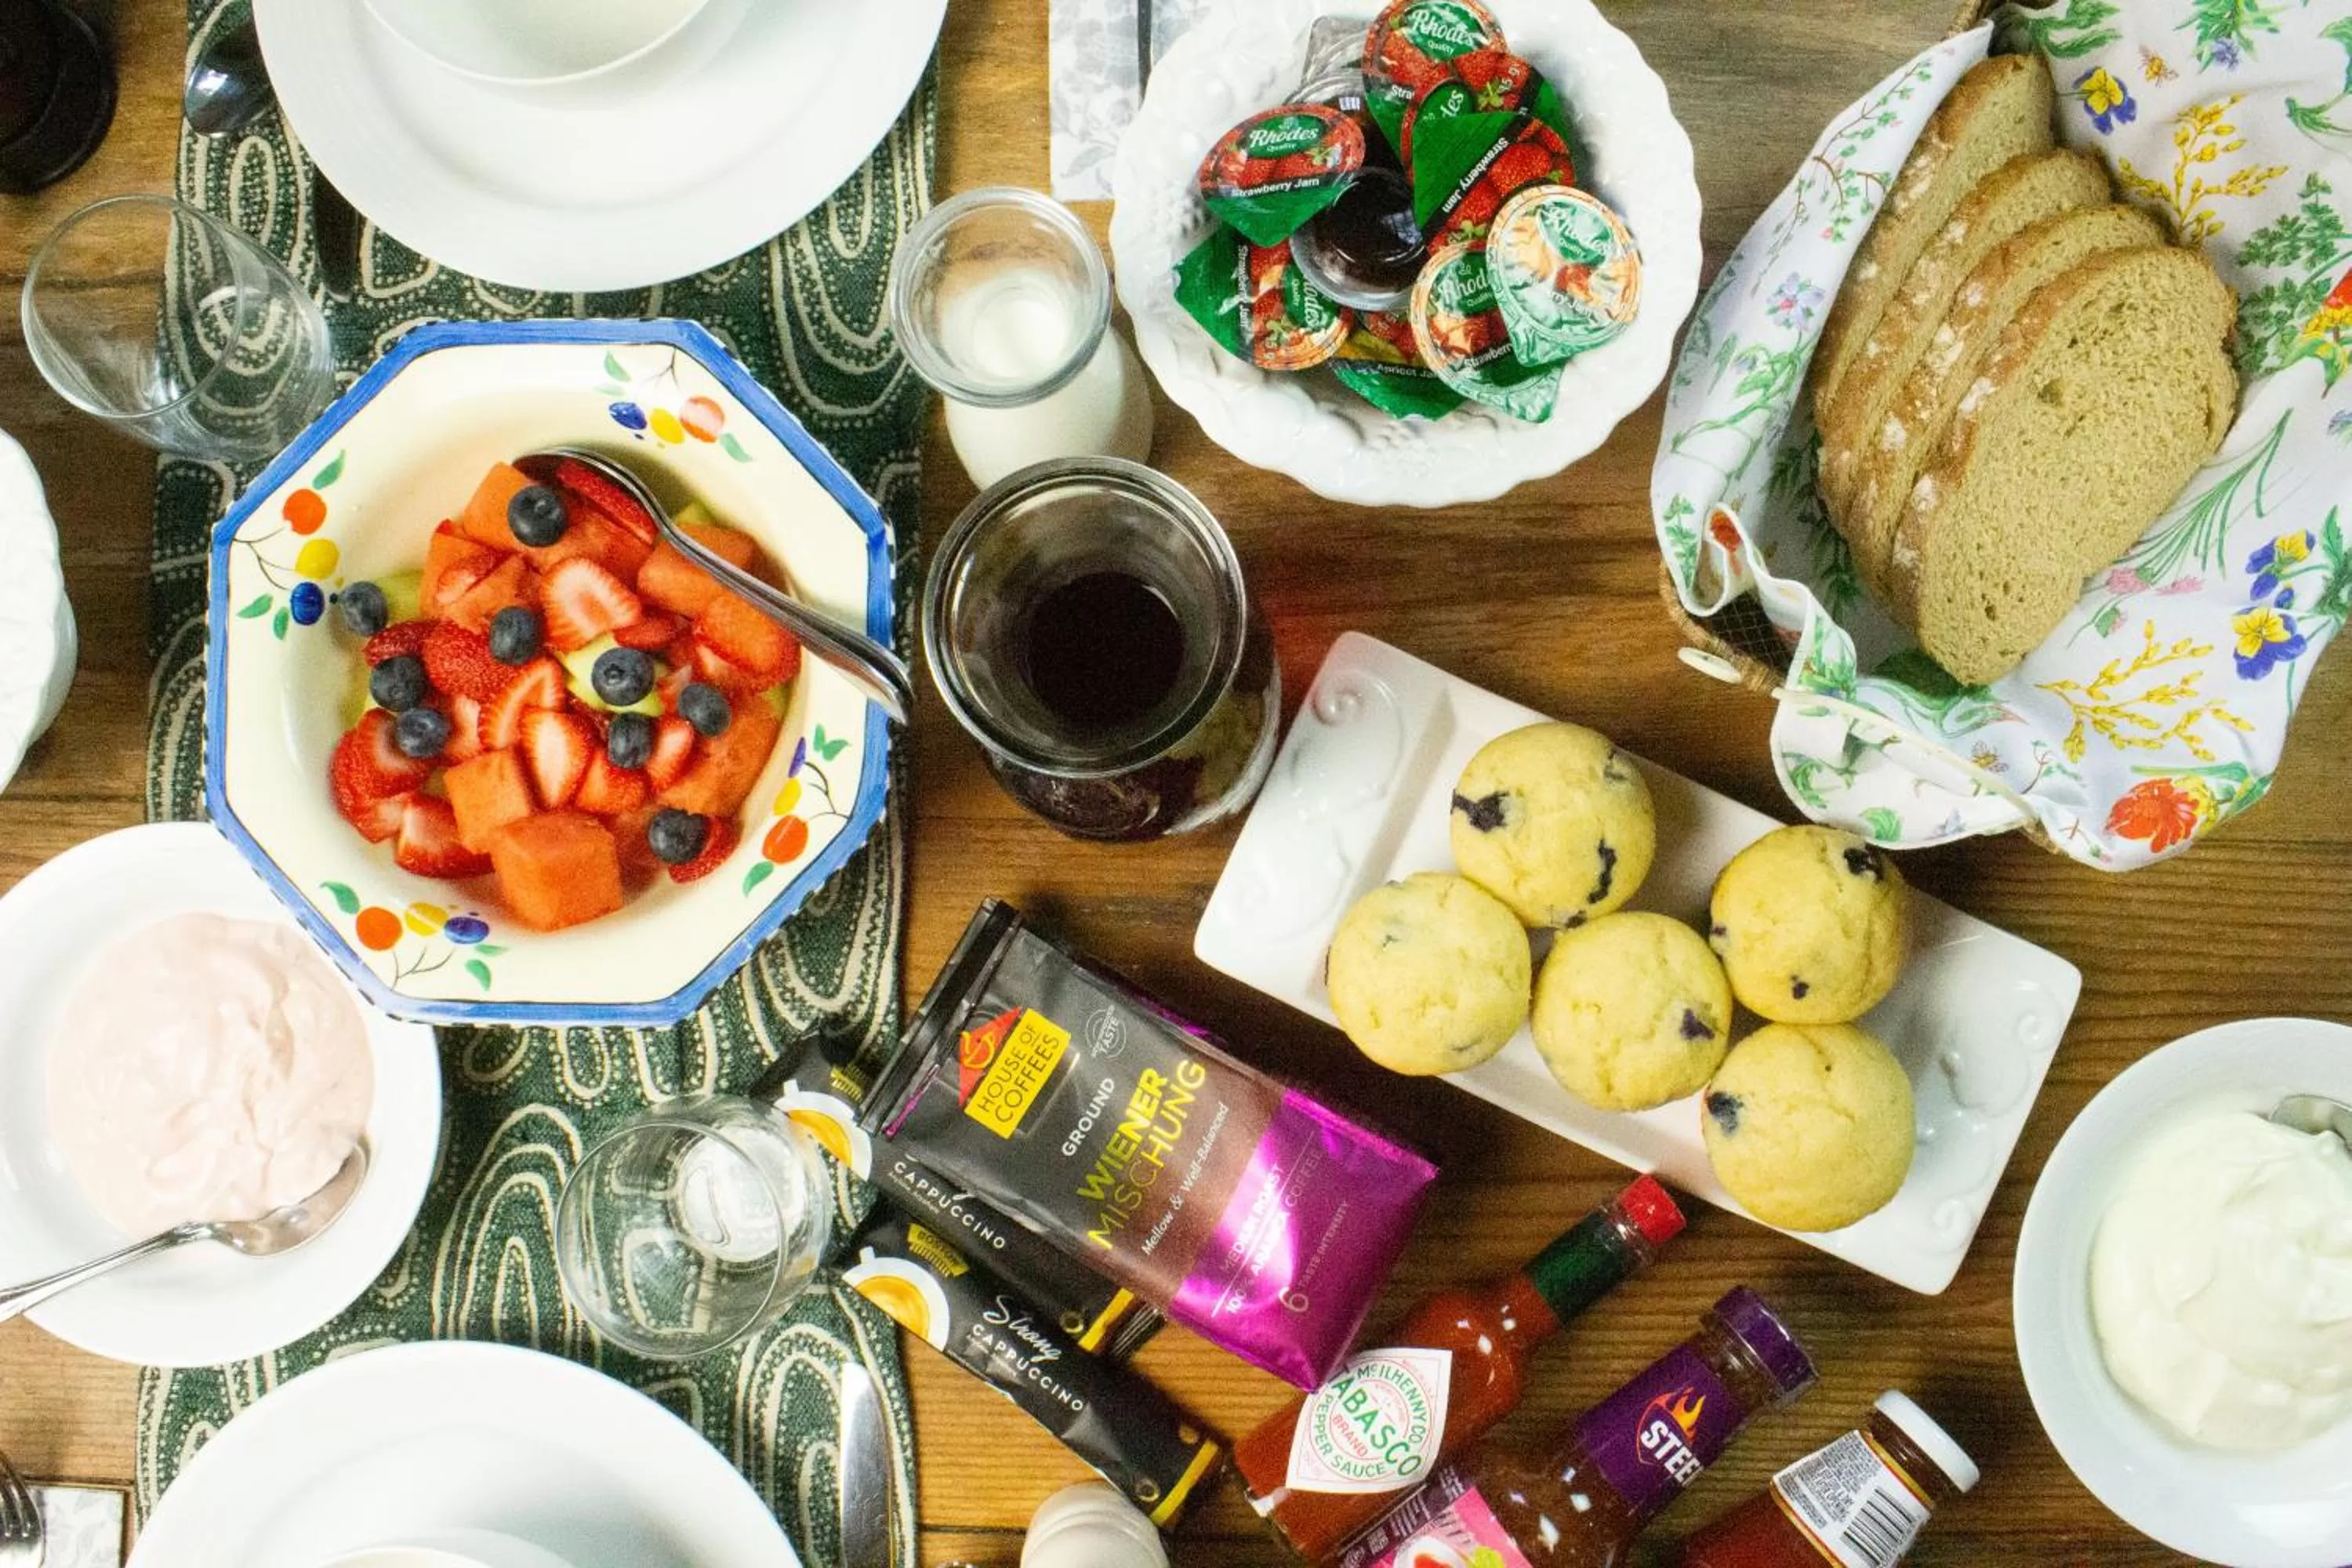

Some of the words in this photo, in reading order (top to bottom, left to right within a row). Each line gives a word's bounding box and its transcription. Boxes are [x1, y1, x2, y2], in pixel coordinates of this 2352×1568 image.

[1410, 9, 1475, 48] Rhodes
[1249, 126, 1319, 149] Rhodes
[1459, 136, 1510, 191] Strawberry
[1231, 180, 1291, 198] Strawberry
[1294, 177, 1320, 189] Jam
[1441, 189, 1462, 213] Jam
[1438, 268, 1489, 312] Rhod
[978, 1047, 1025, 1112] HOUSE
[1020, 1023, 1038, 1045] OF
[1098, 1015, 1120, 1054] TASTE
[995, 1033, 1059, 1123] COFFEES
[1062, 1078, 1115, 1156] GROUND
[1076, 1067, 1168, 1200] WIENER
[1087, 1060, 1205, 1250] MISCHUNG
[1142, 1210, 1174, 1255] Mellow
[1169, 1193, 1185, 1210] &
[1180, 1101, 1229, 1192] Well-Balanced
[894, 1161, 1006, 1249] CAPPUCCINO
[982, 1295, 1062, 1363] Strong
[1279, 1286, 1309, 1313] 6
[973, 1323, 1083, 1410] CAPPUCCINO
[1313, 1393, 1334, 1455] PEPPER
[1330, 1454, 1387, 1478] SAUCE
[1333, 1414, 1368, 1457] BRAND
[1640, 1420, 1704, 1486] STEE
